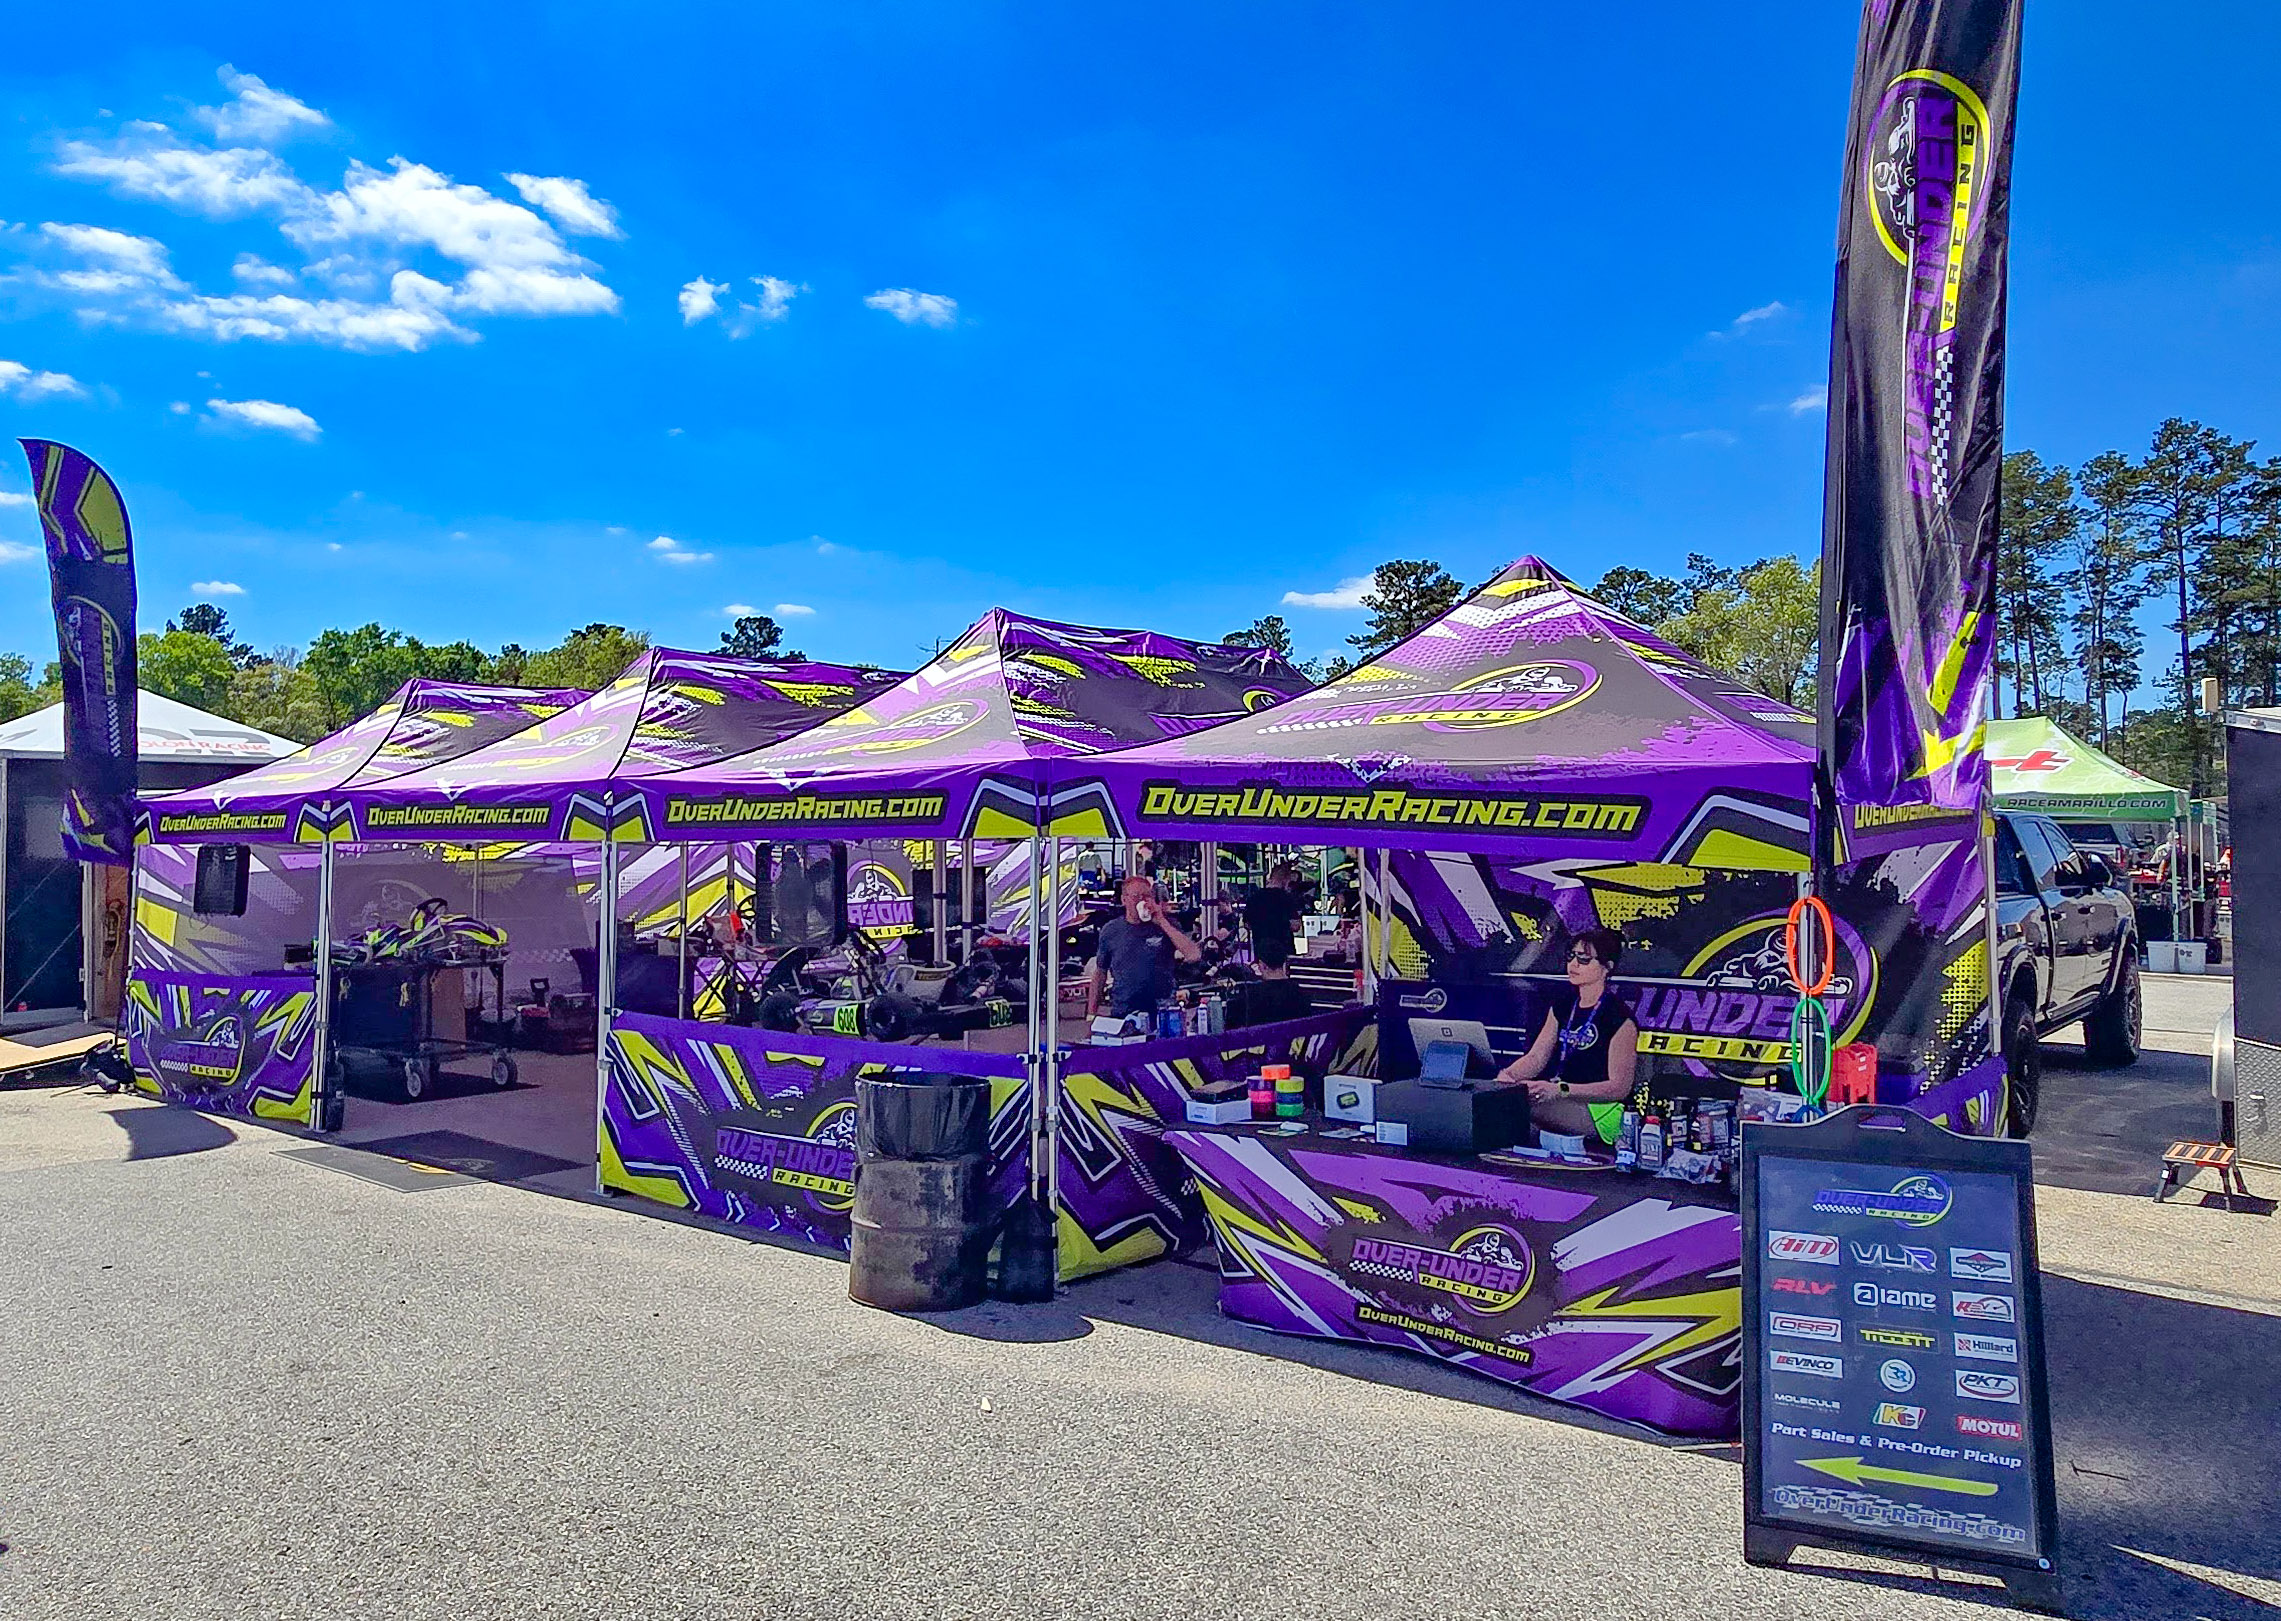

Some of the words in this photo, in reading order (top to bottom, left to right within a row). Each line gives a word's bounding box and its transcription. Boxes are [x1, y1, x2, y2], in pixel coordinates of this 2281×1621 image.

[1944, 124, 1975, 323] RACING
[1276, 693, 1568, 725] OVER-UNDER
[1375, 711, 1519, 724] RACING
[837, 1007, 856, 1033] 608
[1648, 1034, 1802, 1061] ACING
[716, 1129, 856, 1181] OVER-UNDE
[775, 1170, 855, 1195] RACING
[1352, 1239, 1522, 1293] OVER-UNDER
[1421, 1273, 1505, 1302] RACING
[1972, 1339, 2014, 1353] Hilliard
[1963, 1373, 2009, 1388] PKT
[1773, 1392, 1841, 1409] MOLECULE
[1960, 1418, 2019, 1438] MOTUL
[1771, 1422, 1807, 1438] Part
[1810, 1427, 1855, 1444] Sales
[1859, 1434, 1873, 1447] &
[1877, 1437, 1960, 1459] Pre-Order
[1963, 1449, 2023, 1470] Pickup
